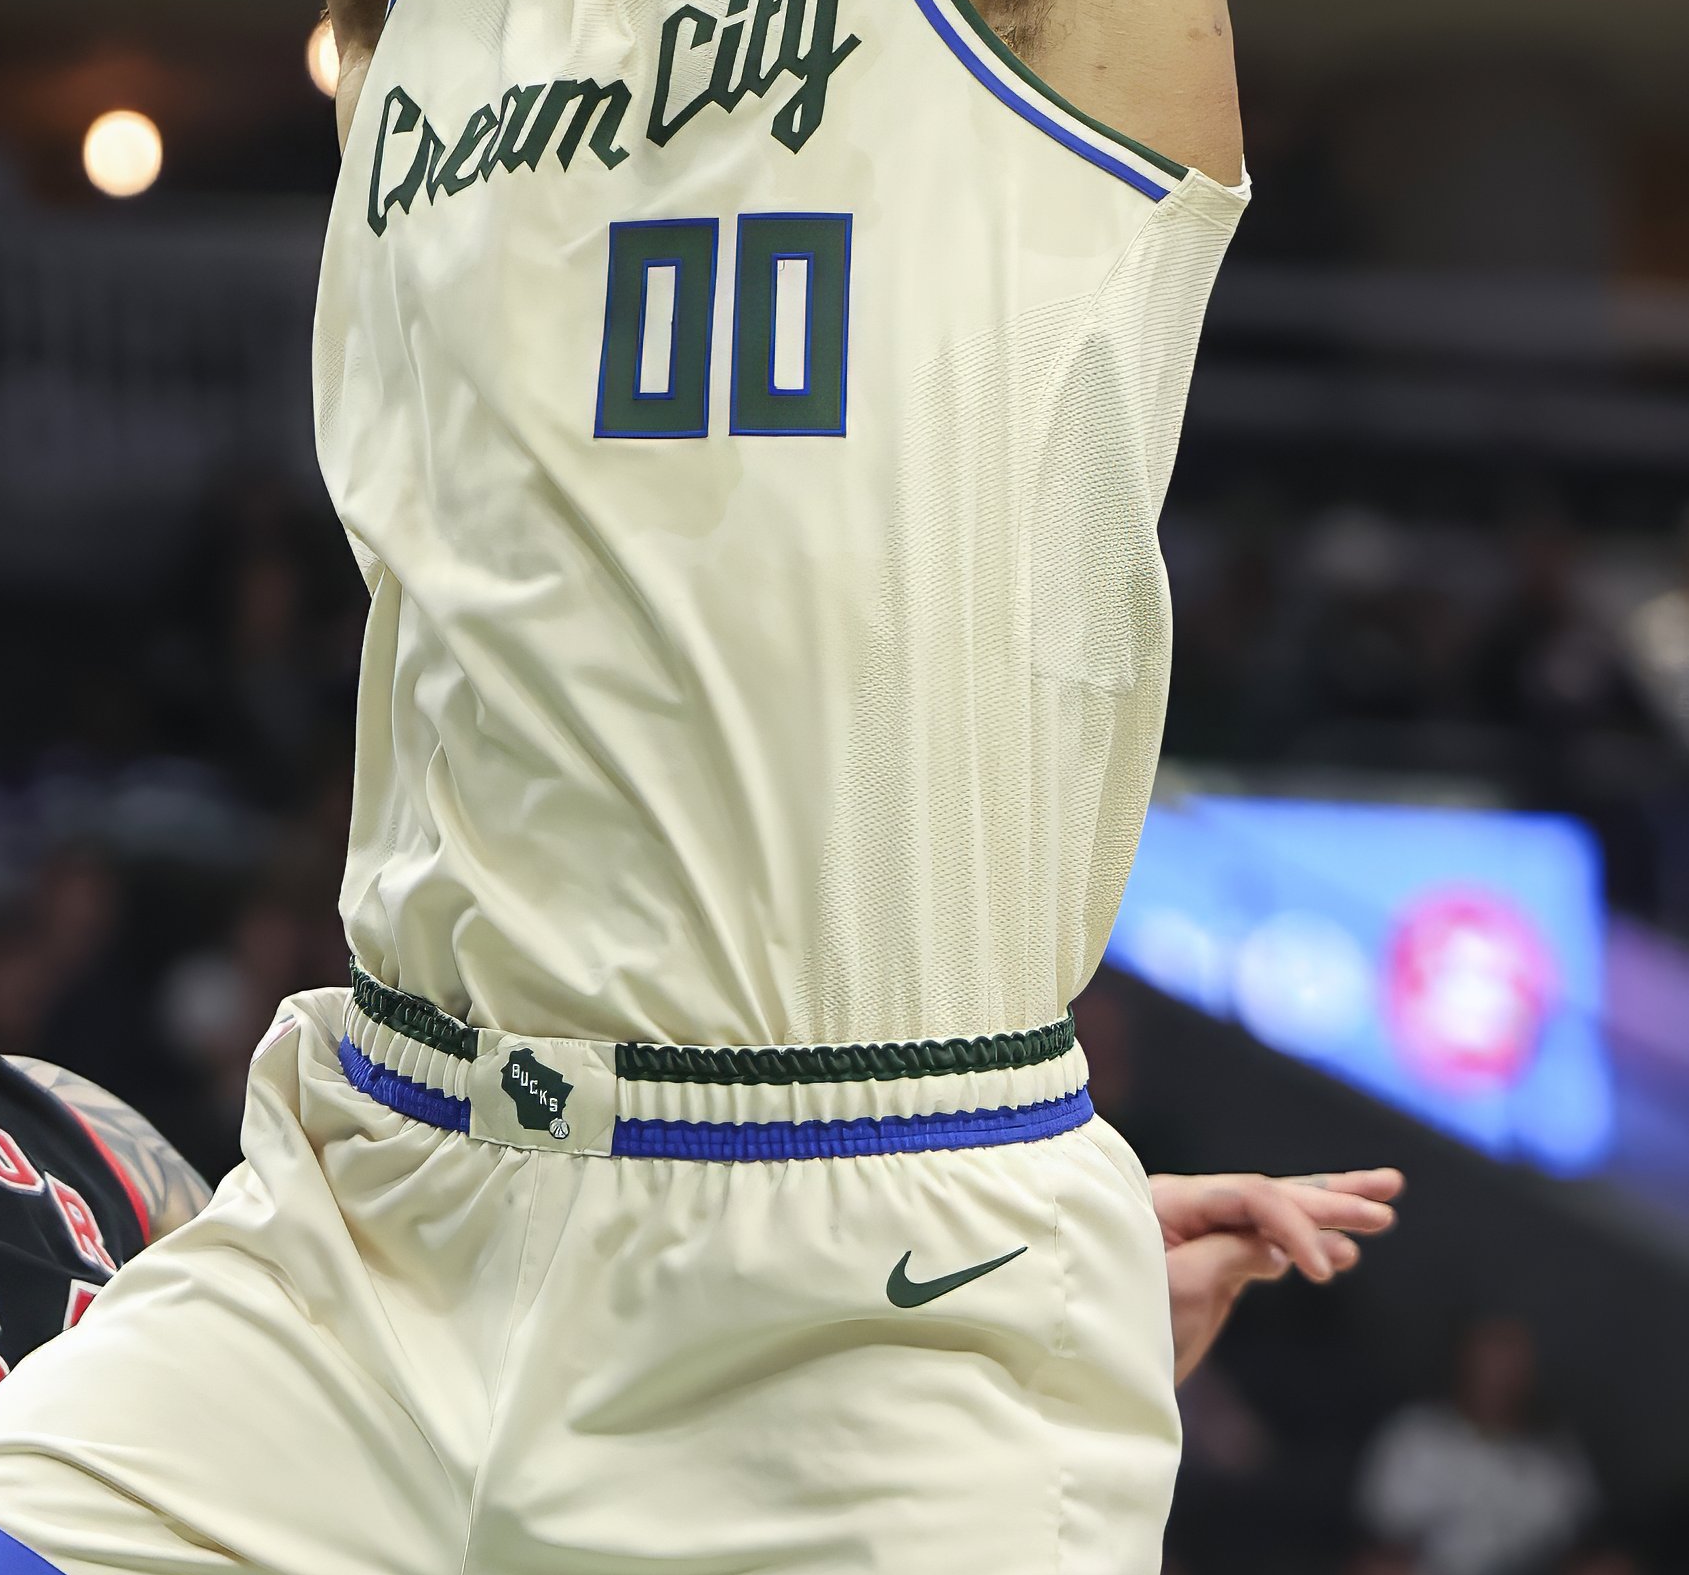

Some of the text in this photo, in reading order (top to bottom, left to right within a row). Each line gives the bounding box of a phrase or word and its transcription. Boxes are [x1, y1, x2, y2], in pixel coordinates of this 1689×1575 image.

[367, 75, 632, 238] Cream
[593, 212, 854, 439] 00
[511, 1063, 559, 1113] BUCKS
